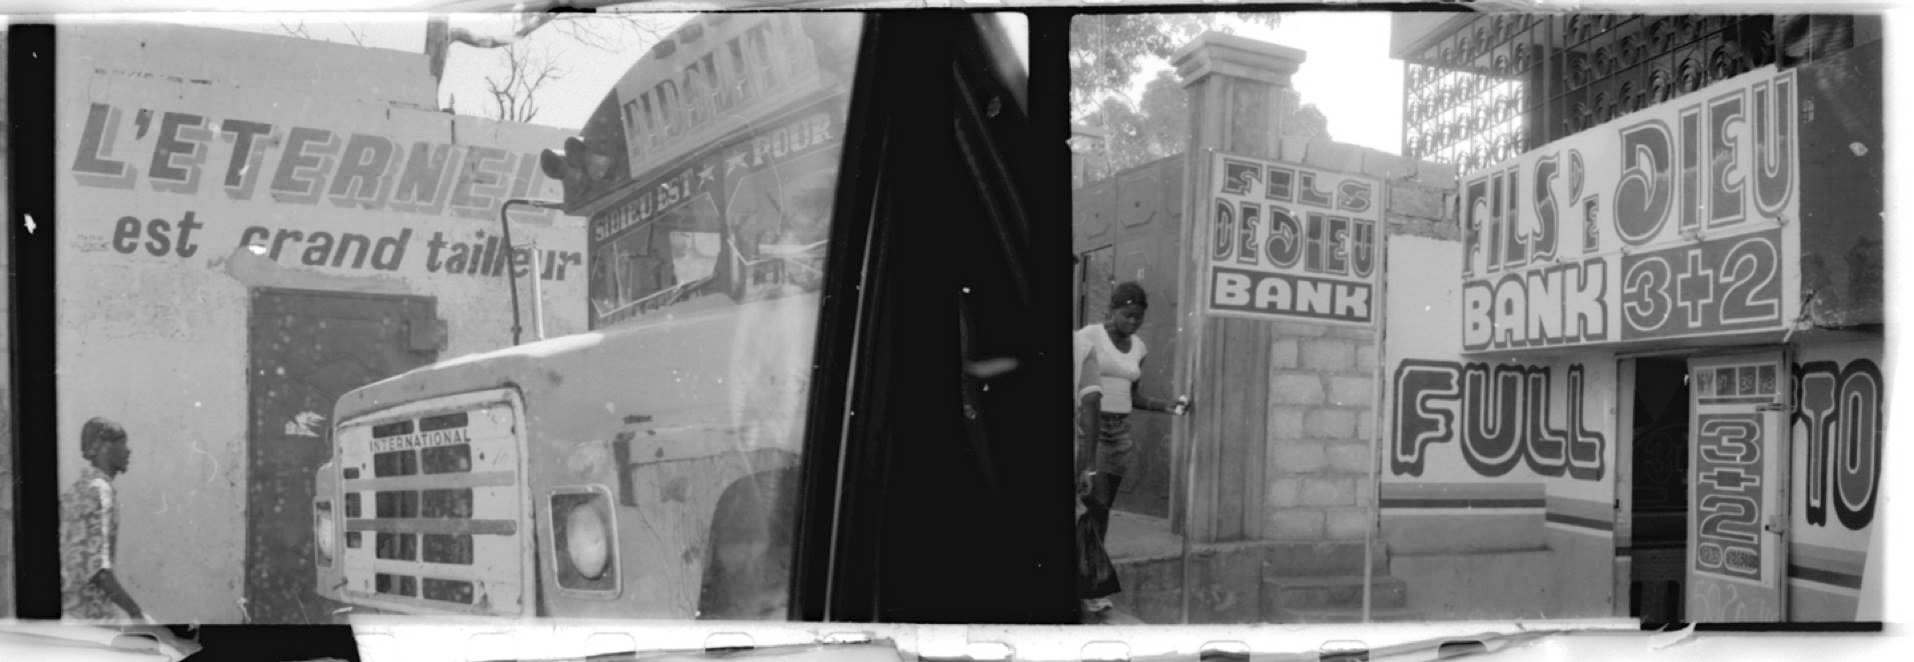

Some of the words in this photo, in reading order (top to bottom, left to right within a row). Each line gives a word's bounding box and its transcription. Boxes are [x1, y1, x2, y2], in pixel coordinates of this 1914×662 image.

[657, 167, 694, 211] EST
[751, 112, 834, 167] POUR
[1221, 157, 1373, 213] FILS
[1462, 151, 1560, 279] FILS
[1613, 71, 1797, 246] DIEU
[112, 211, 203, 258] est
[426, 228, 582, 281] tailleur
[1214, 271, 1369, 319] BANK
[1462, 256, 1608, 351] BANK
[1622, 236, 1779, 332] 3+2
[369, 428, 472, 454] INTERNATIONAL
[1391, 358, 1605, 481] FULL
